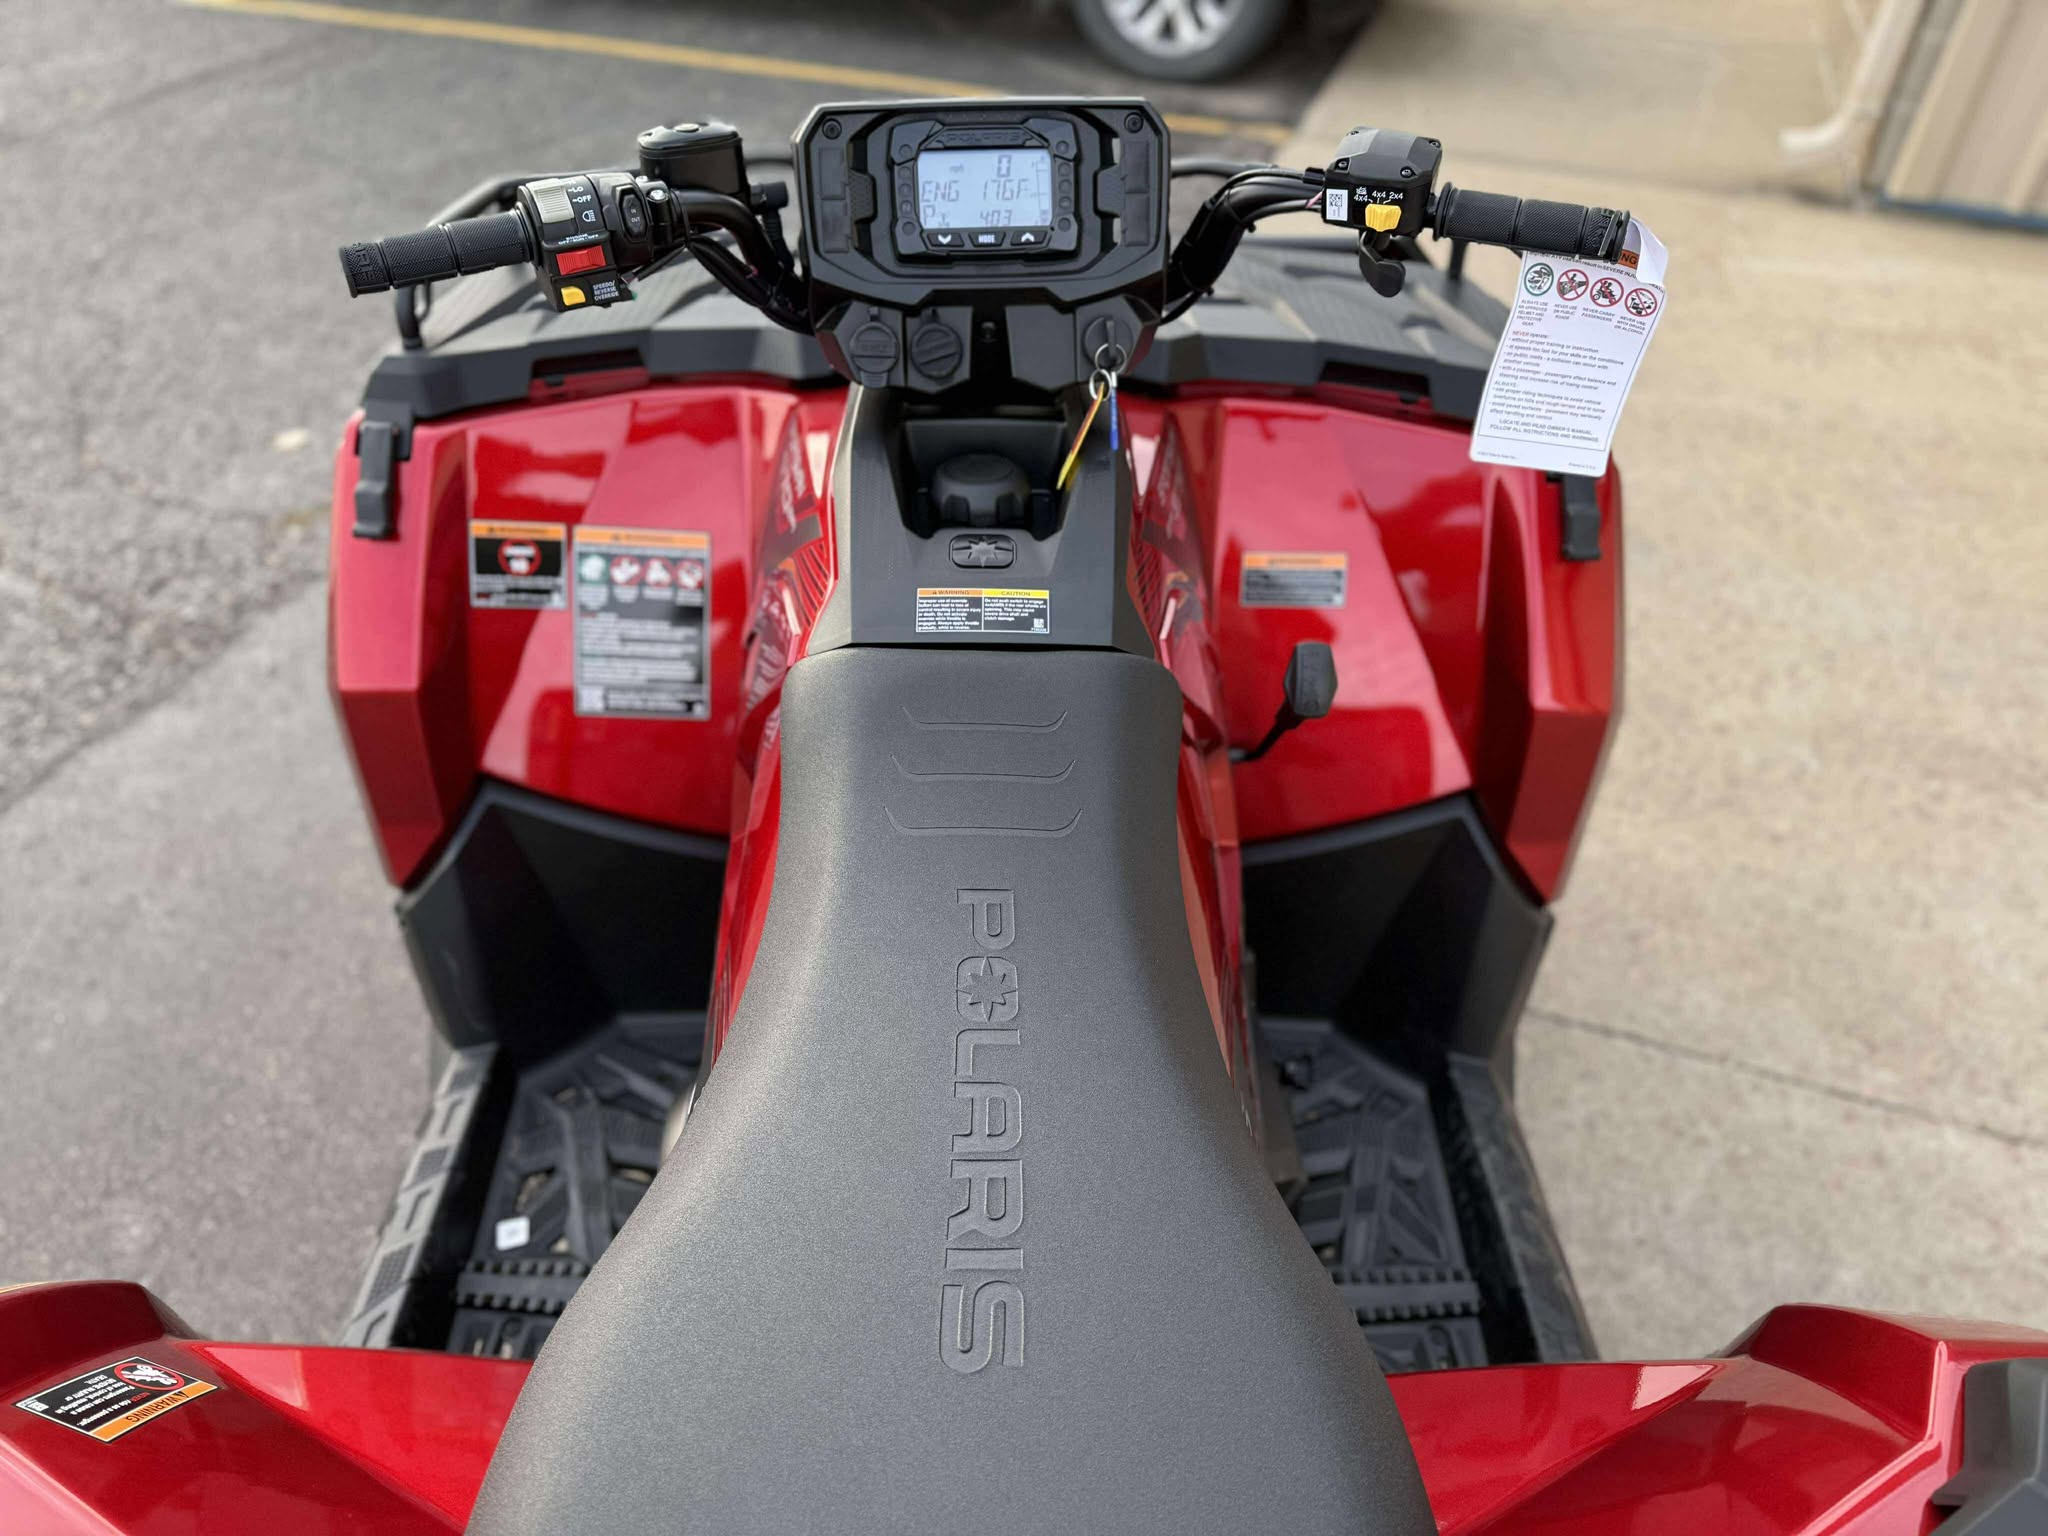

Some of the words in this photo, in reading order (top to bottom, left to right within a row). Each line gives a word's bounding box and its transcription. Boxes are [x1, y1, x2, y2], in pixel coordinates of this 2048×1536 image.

[922, 180, 959, 203] ENG
[1372, 190, 1386, 198] 4x4
[1389, 191, 1404, 200] 2x4
[577, 195, 592, 203] OFF
[1354, 194, 1368, 202] 4x4
[594, 291, 619, 301] OVERRIDE
[939, 888, 1025, 1374] POLARIS
[126, 1395, 182, 1423] WARNING
